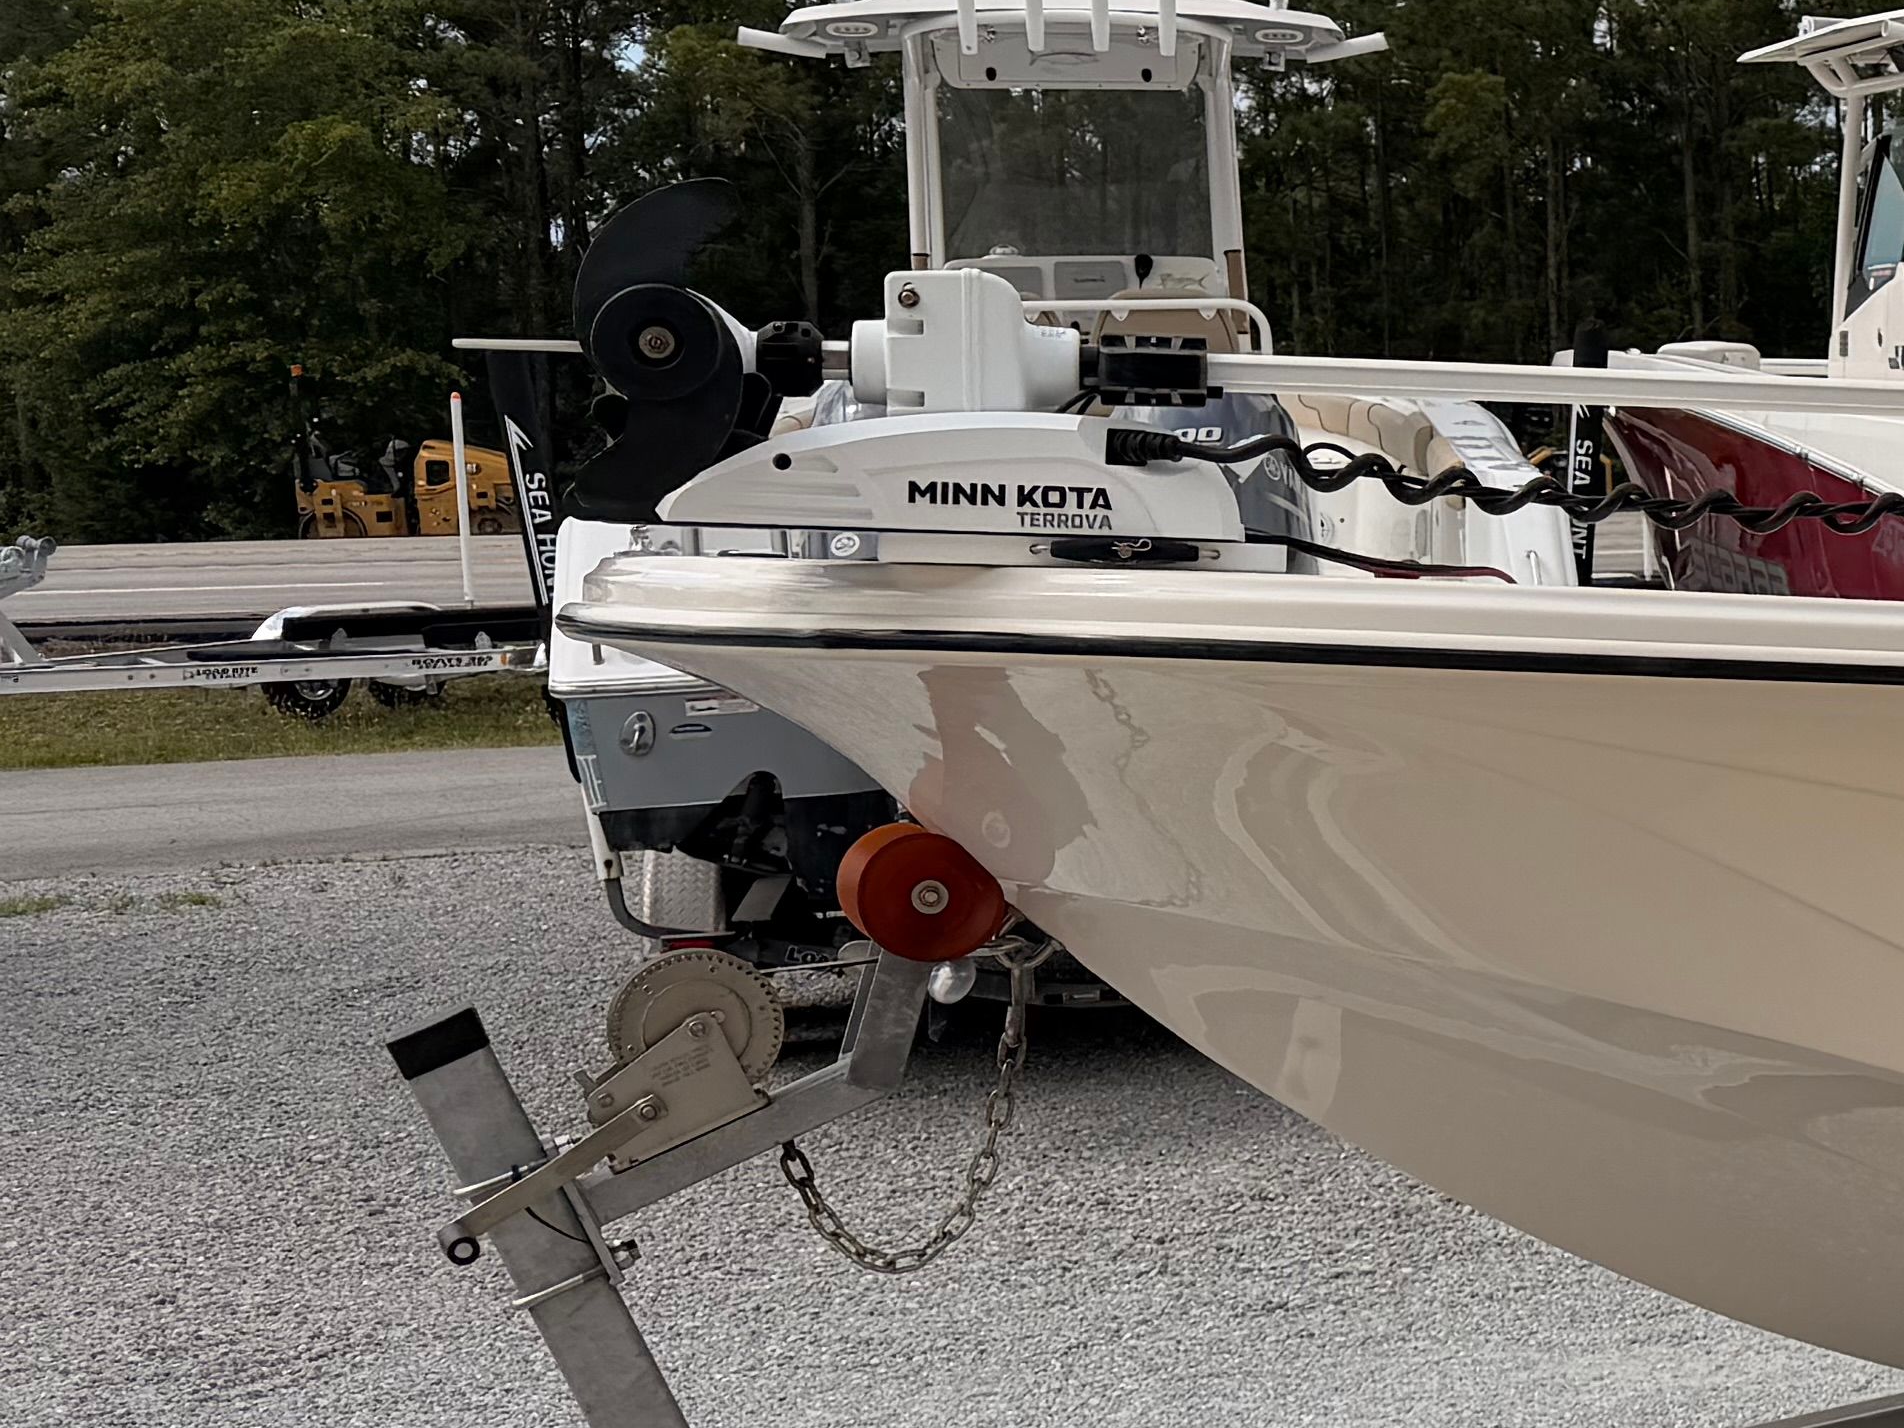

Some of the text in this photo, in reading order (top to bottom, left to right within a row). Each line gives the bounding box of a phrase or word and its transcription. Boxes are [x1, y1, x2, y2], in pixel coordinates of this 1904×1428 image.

[1174, 426, 1223, 444] 00
[525, 472, 552, 524] SEA
[907, 480, 1114, 511] MINN KOTA
[1572, 439, 1594, 559] SEA UNT
[1016, 510, 1114, 531] TERROVA
